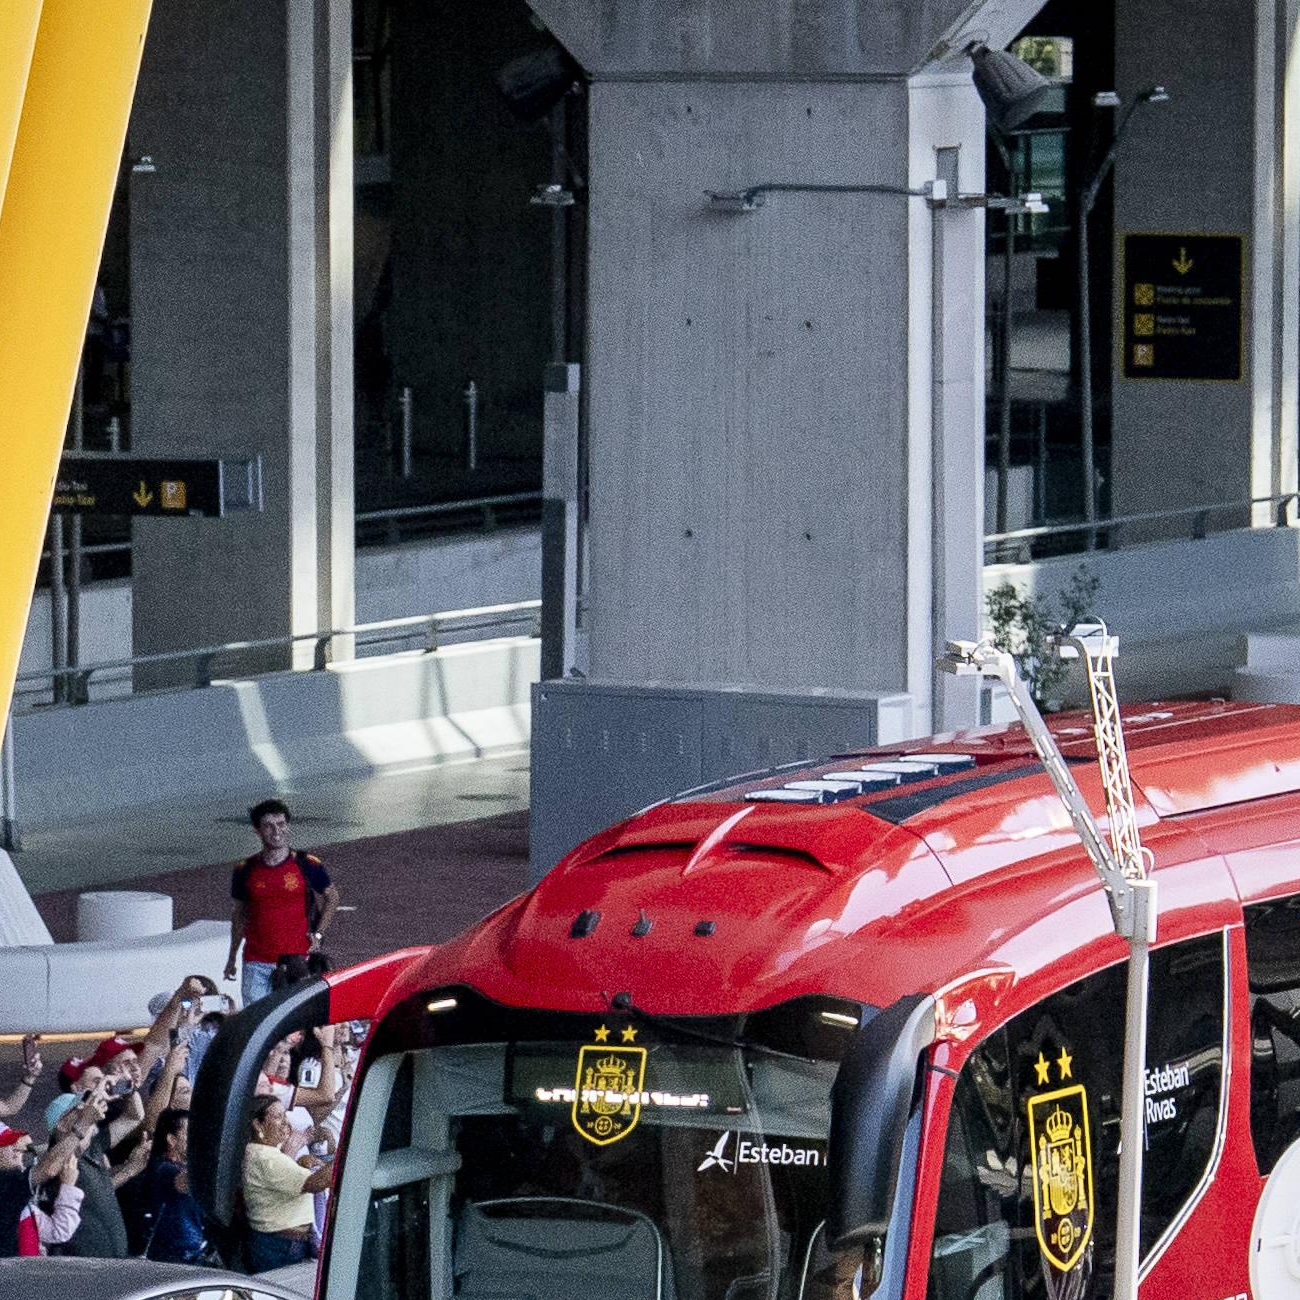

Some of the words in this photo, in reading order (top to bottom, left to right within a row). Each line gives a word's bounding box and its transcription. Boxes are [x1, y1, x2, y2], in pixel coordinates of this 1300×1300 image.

[1144, 1063, 1190, 1096] Esteban
[1146, 1097, 1177, 1124] Rivas
[738, 1141, 819, 1167] Esteban
